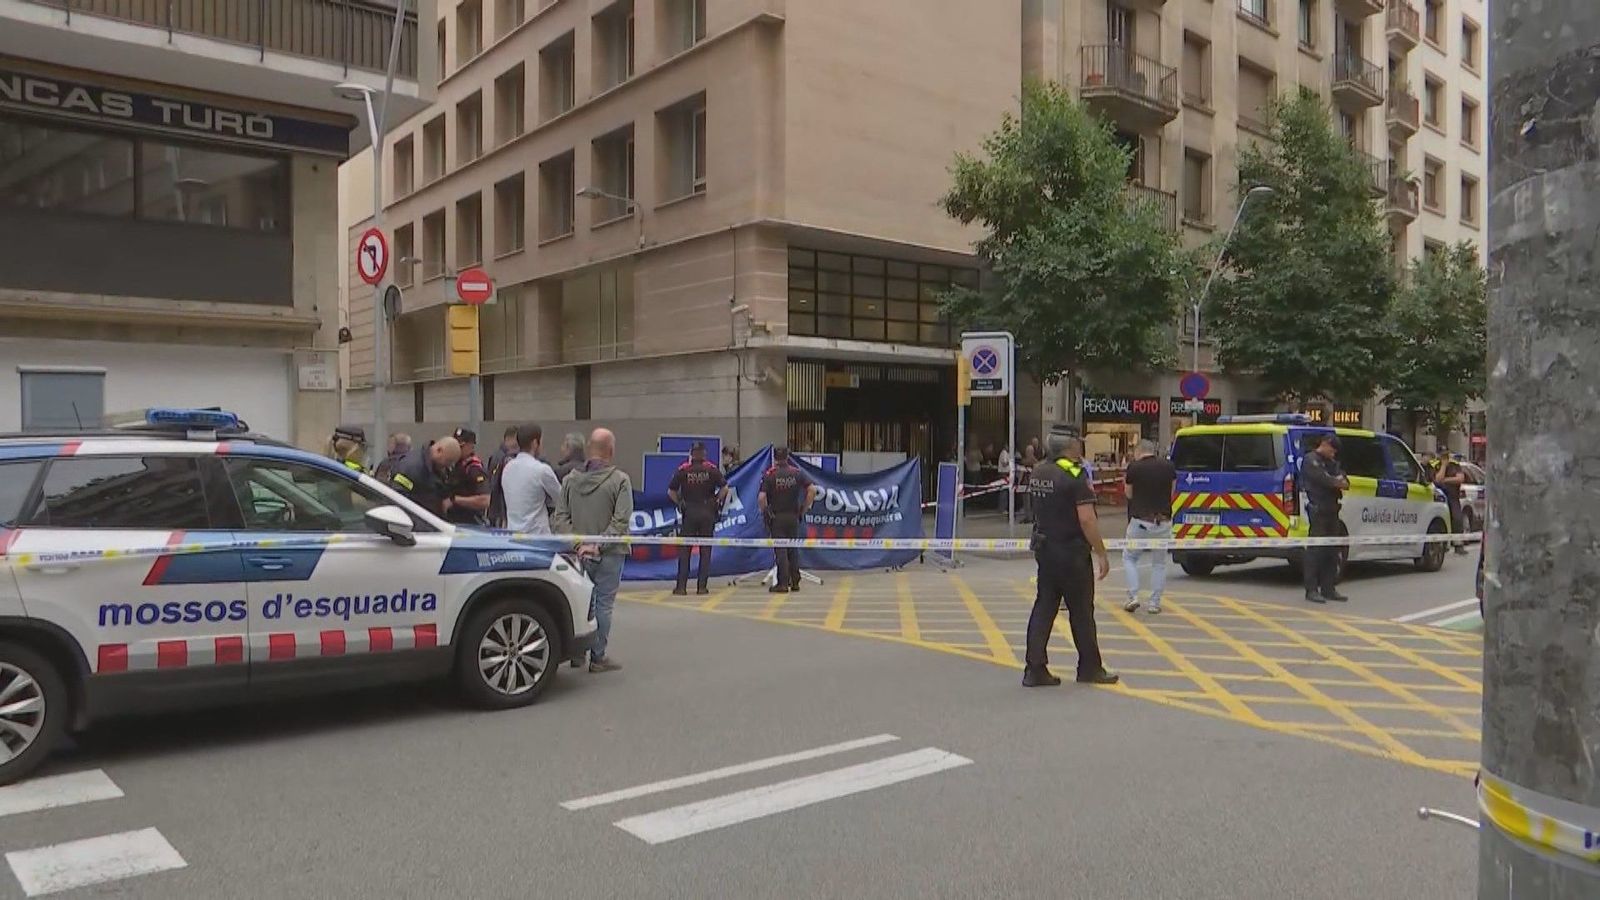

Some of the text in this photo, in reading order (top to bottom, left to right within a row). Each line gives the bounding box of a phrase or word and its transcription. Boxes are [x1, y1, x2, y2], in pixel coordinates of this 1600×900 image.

[151, 98, 274, 138] TURÓ
[1083, 398, 1159, 413] PERSONAL FOTO
[809, 485, 900, 512] POLICIA
[805, 513, 848, 525] mossos
[98, 588, 437, 627] mossos d'esquadra
